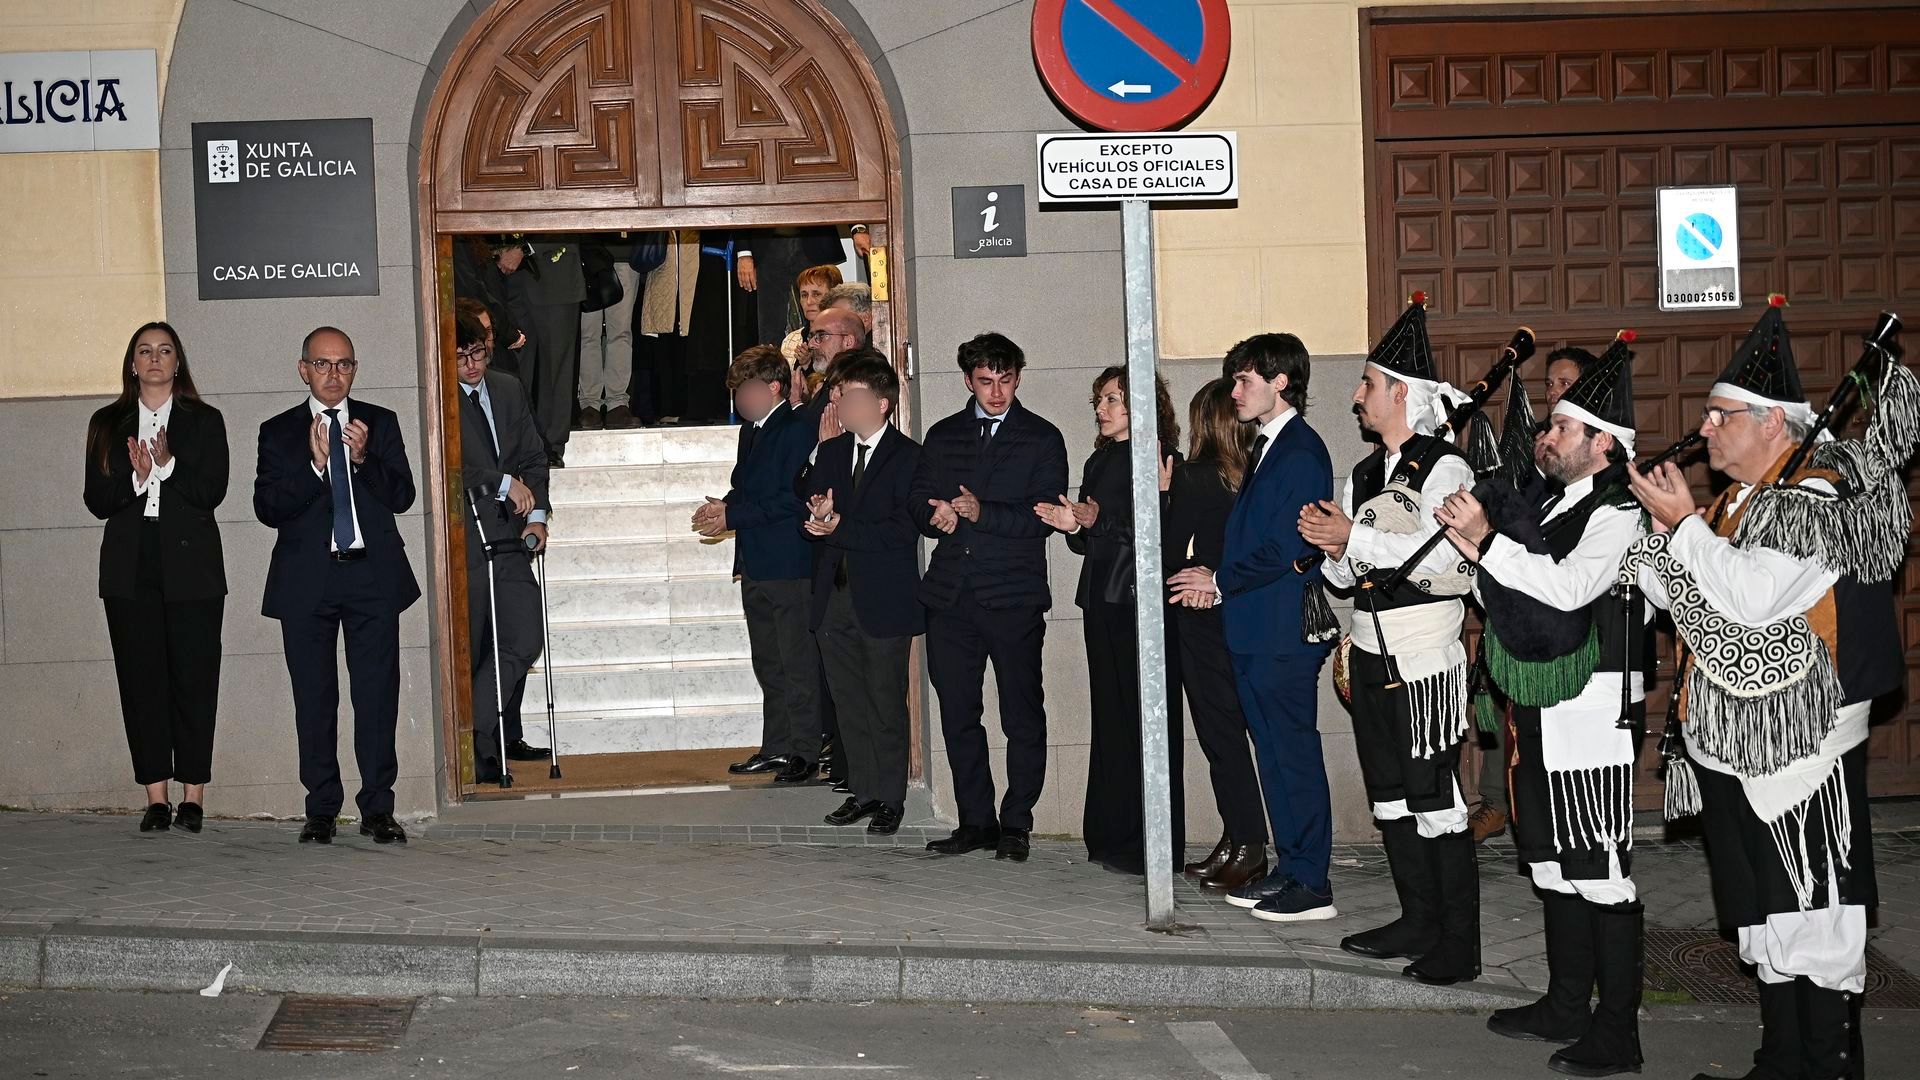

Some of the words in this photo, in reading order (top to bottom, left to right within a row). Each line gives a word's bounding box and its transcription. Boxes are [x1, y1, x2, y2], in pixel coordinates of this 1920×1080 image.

[0, 79, 127, 124] LICIA
[245, 142, 314, 159] XUNTA
[1100, 143, 1173, 156] EXCEPTO
[246, 162, 271, 178] DE
[277, 160, 357, 178] GALICIA
[1047, 159, 1139, 174] VEHÍCULOS
[1143, 159, 1225, 172] OFICIALES
[1069, 178, 1113, 190] CASA
[1117, 177, 1138, 189] DE
[1142, 176, 1206, 189] GALICIA
[968, 236, 1013, 253] galicia
[213, 265, 260, 281] CASA
[264, 264, 287, 280] DE
[291, 262, 361, 279] GALICIA
[1666, 291, 1735, 304] 0300025056
